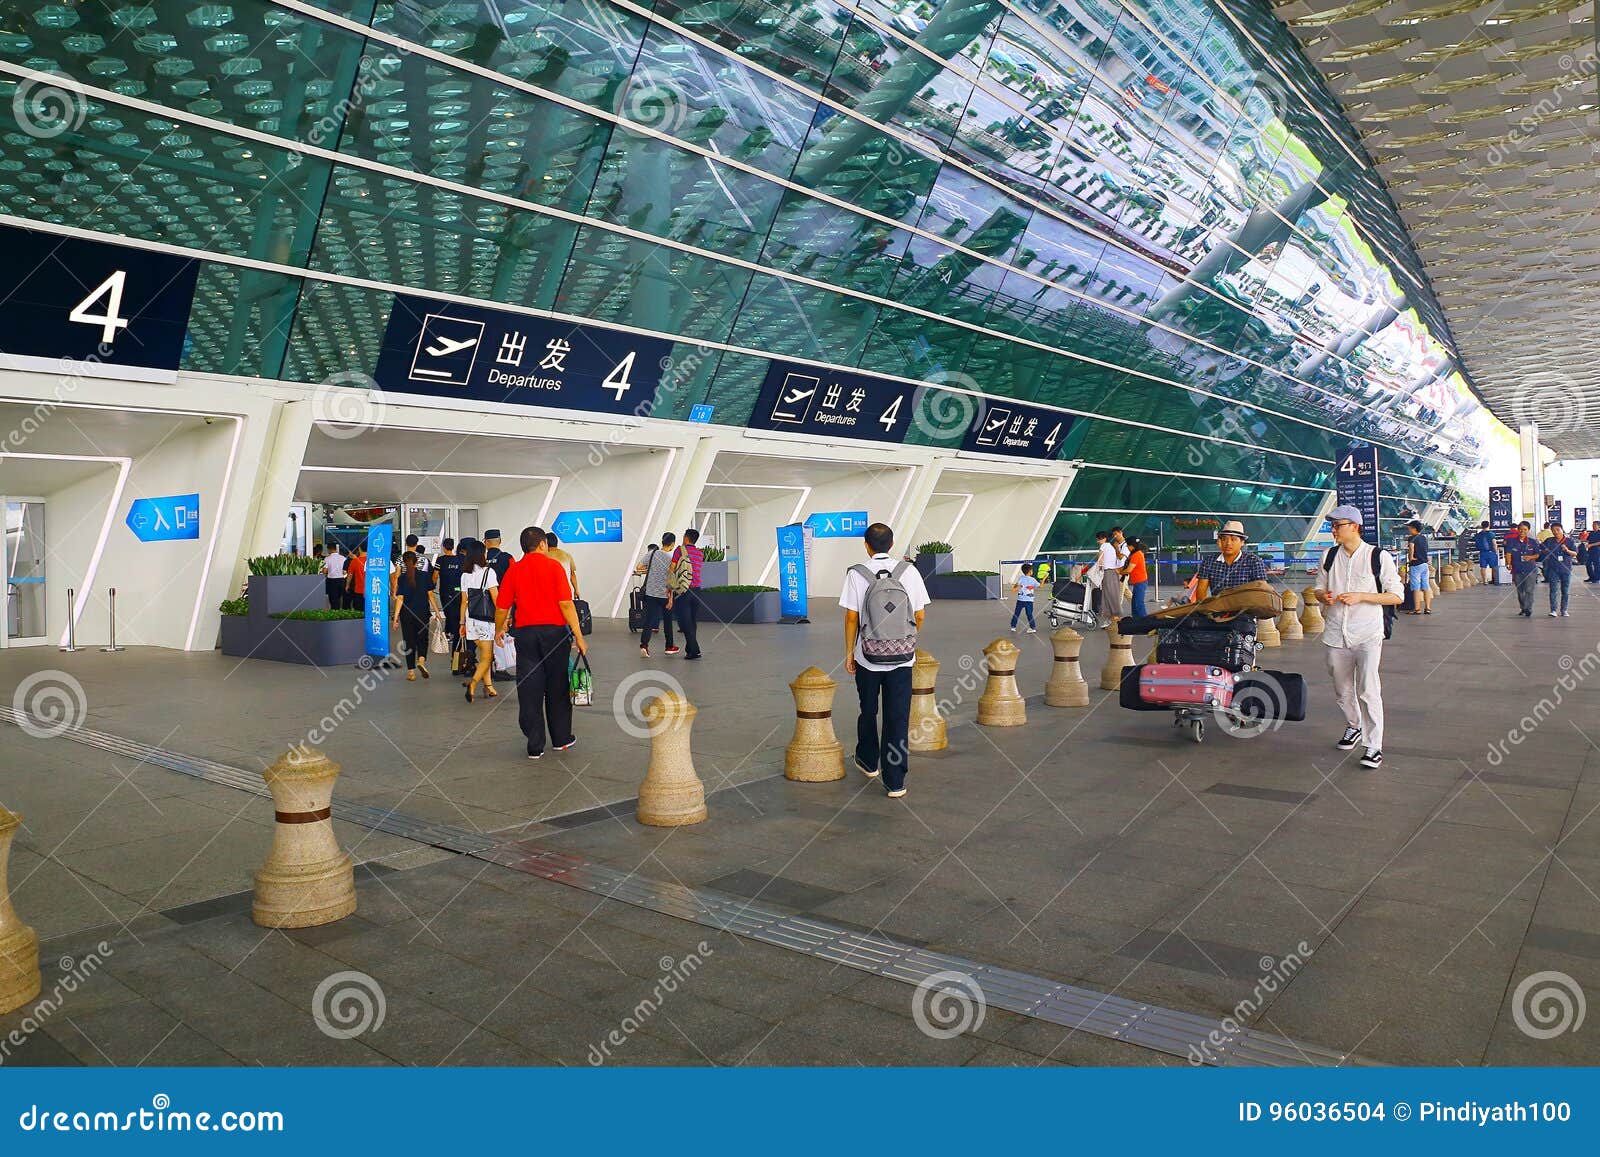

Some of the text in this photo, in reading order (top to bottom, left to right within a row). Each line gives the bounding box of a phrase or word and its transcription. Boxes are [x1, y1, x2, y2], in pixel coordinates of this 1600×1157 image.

[69, 270, 128, 343] 4
[496, 331, 571, 373] 出发
[487, 368, 563, 391] Departures
[601, 351, 637, 401] 4
[821, 383, 866, 414] 出发
[814, 410, 857, 427] Departures
[879, 395, 904, 433] 4
[1009, 415, 1039, 438] 出发
[1003, 435, 1030, 448] Departures
[1043, 422, 1063, 452] 4
[1340, 454, 1356, 477] 4
[1492, 489, 1502, 502] 3
[154, 506, 187, 531] 入口
[574, 517, 606, 536] 入口
[824, 517, 853, 533] 入口
[787, 561, 799, 602] 航站楼
[371, 576, 382, 635] 航站楼
